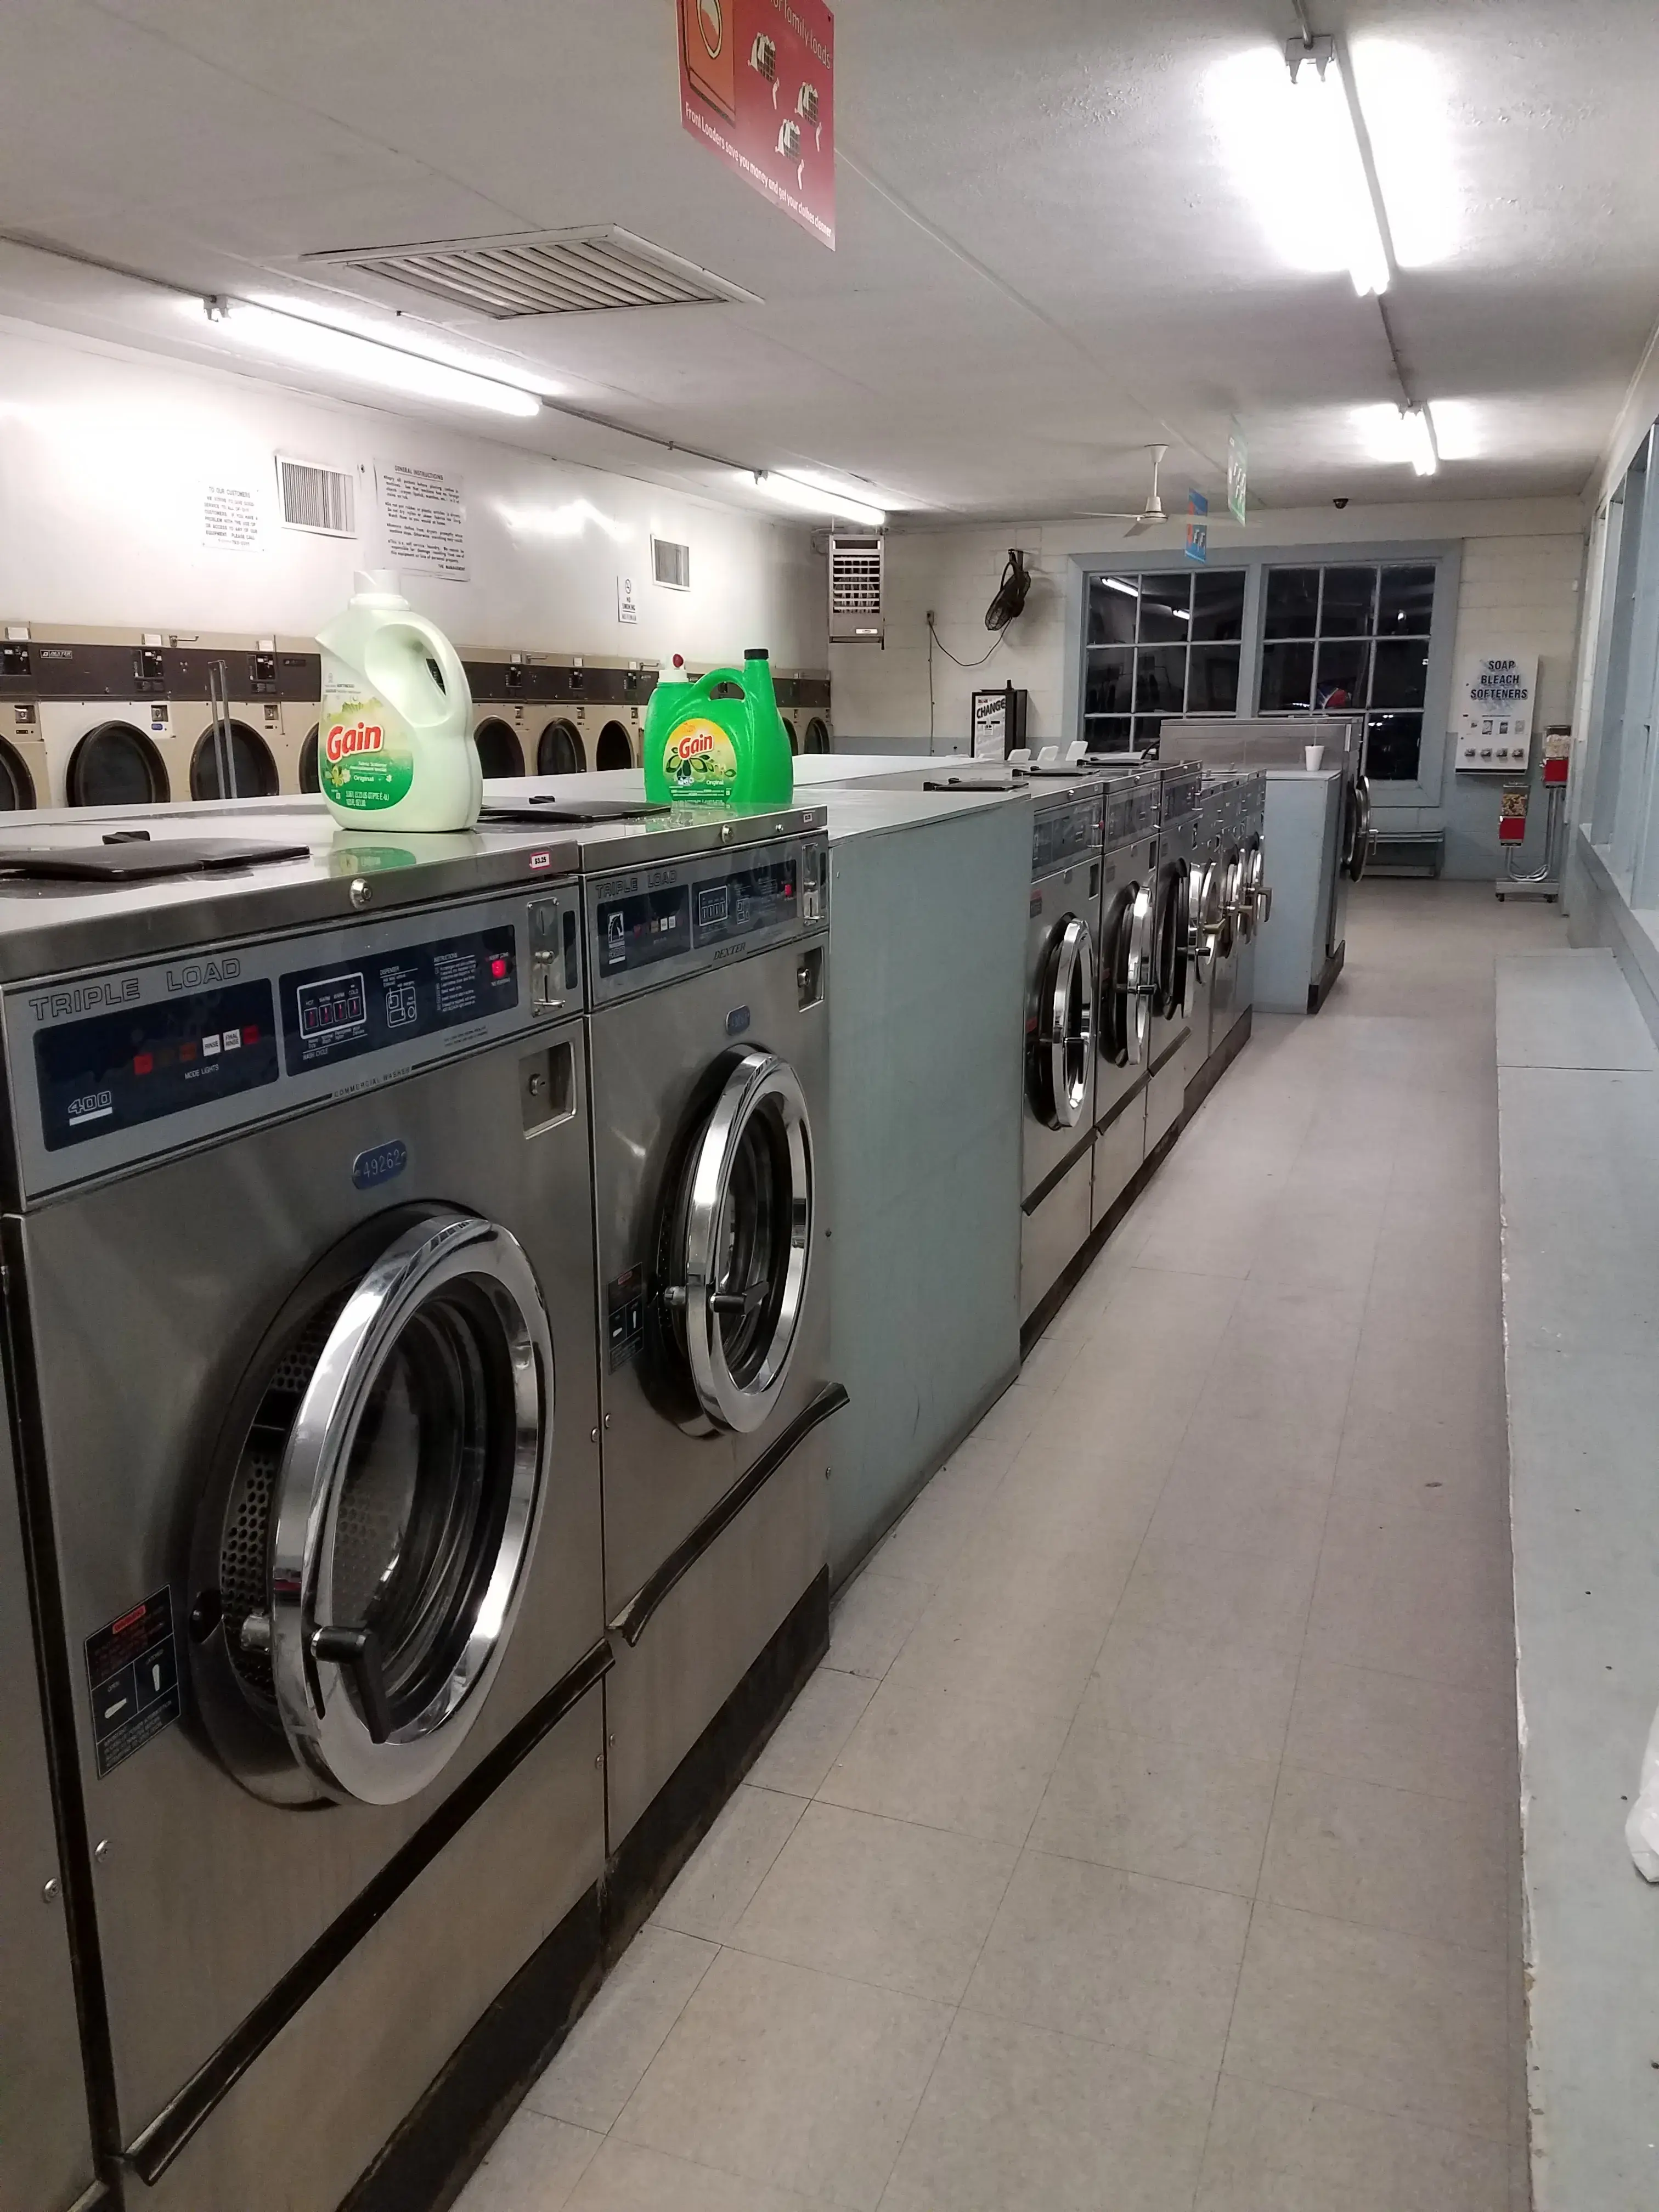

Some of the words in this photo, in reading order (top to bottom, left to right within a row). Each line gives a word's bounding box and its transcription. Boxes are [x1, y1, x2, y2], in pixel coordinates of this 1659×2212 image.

[784, 0, 809, 47] family
[810, 28, 830, 69] loads
[686, 101, 701, 129] Front
[702, 116, 725, 150] Loaders
[725, 142, 738, 161] save
[739, 154, 749, 172] you
[750, 163, 768, 188] money
[768, 178, 778, 195] and
[787, 194, 798, 211] your
[798, 202, 814, 224] clothes
[815, 216, 831, 237] cleaner
[394, 465, 413, 474] GENERAL
[413, 470, 443, 481] INSTRUCTIONS
[1488, 661, 1515, 670] SOAP
[1481, 675, 1519, 684] BLEACH
[1471, 689, 1527, 699] SOFTENERS
[977, 698, 1006, 719] CHANGE
[326, 722, 382, 761] Gain
[679, 733, 713, 759] Gain
[595, 877, 637, 899] TRIPLE
[647, 869, 676, 888] LOAD
[713, 942, 746, 961] DEXTER
[29, 978, 140, 1020] TRIPLE
[166, 958, 240, 992] LOAD
[185, 1069, 199, 1079] MODE
[201, 1064, 219, 1074] LIGHTS
[334, 1077, 380, 1098] COMMERCIAL
[383, 1066, 410, 1081] WASHER
[67, 1091, 111, 1114] 400
[364, 1149, 401, 1178] 49262
